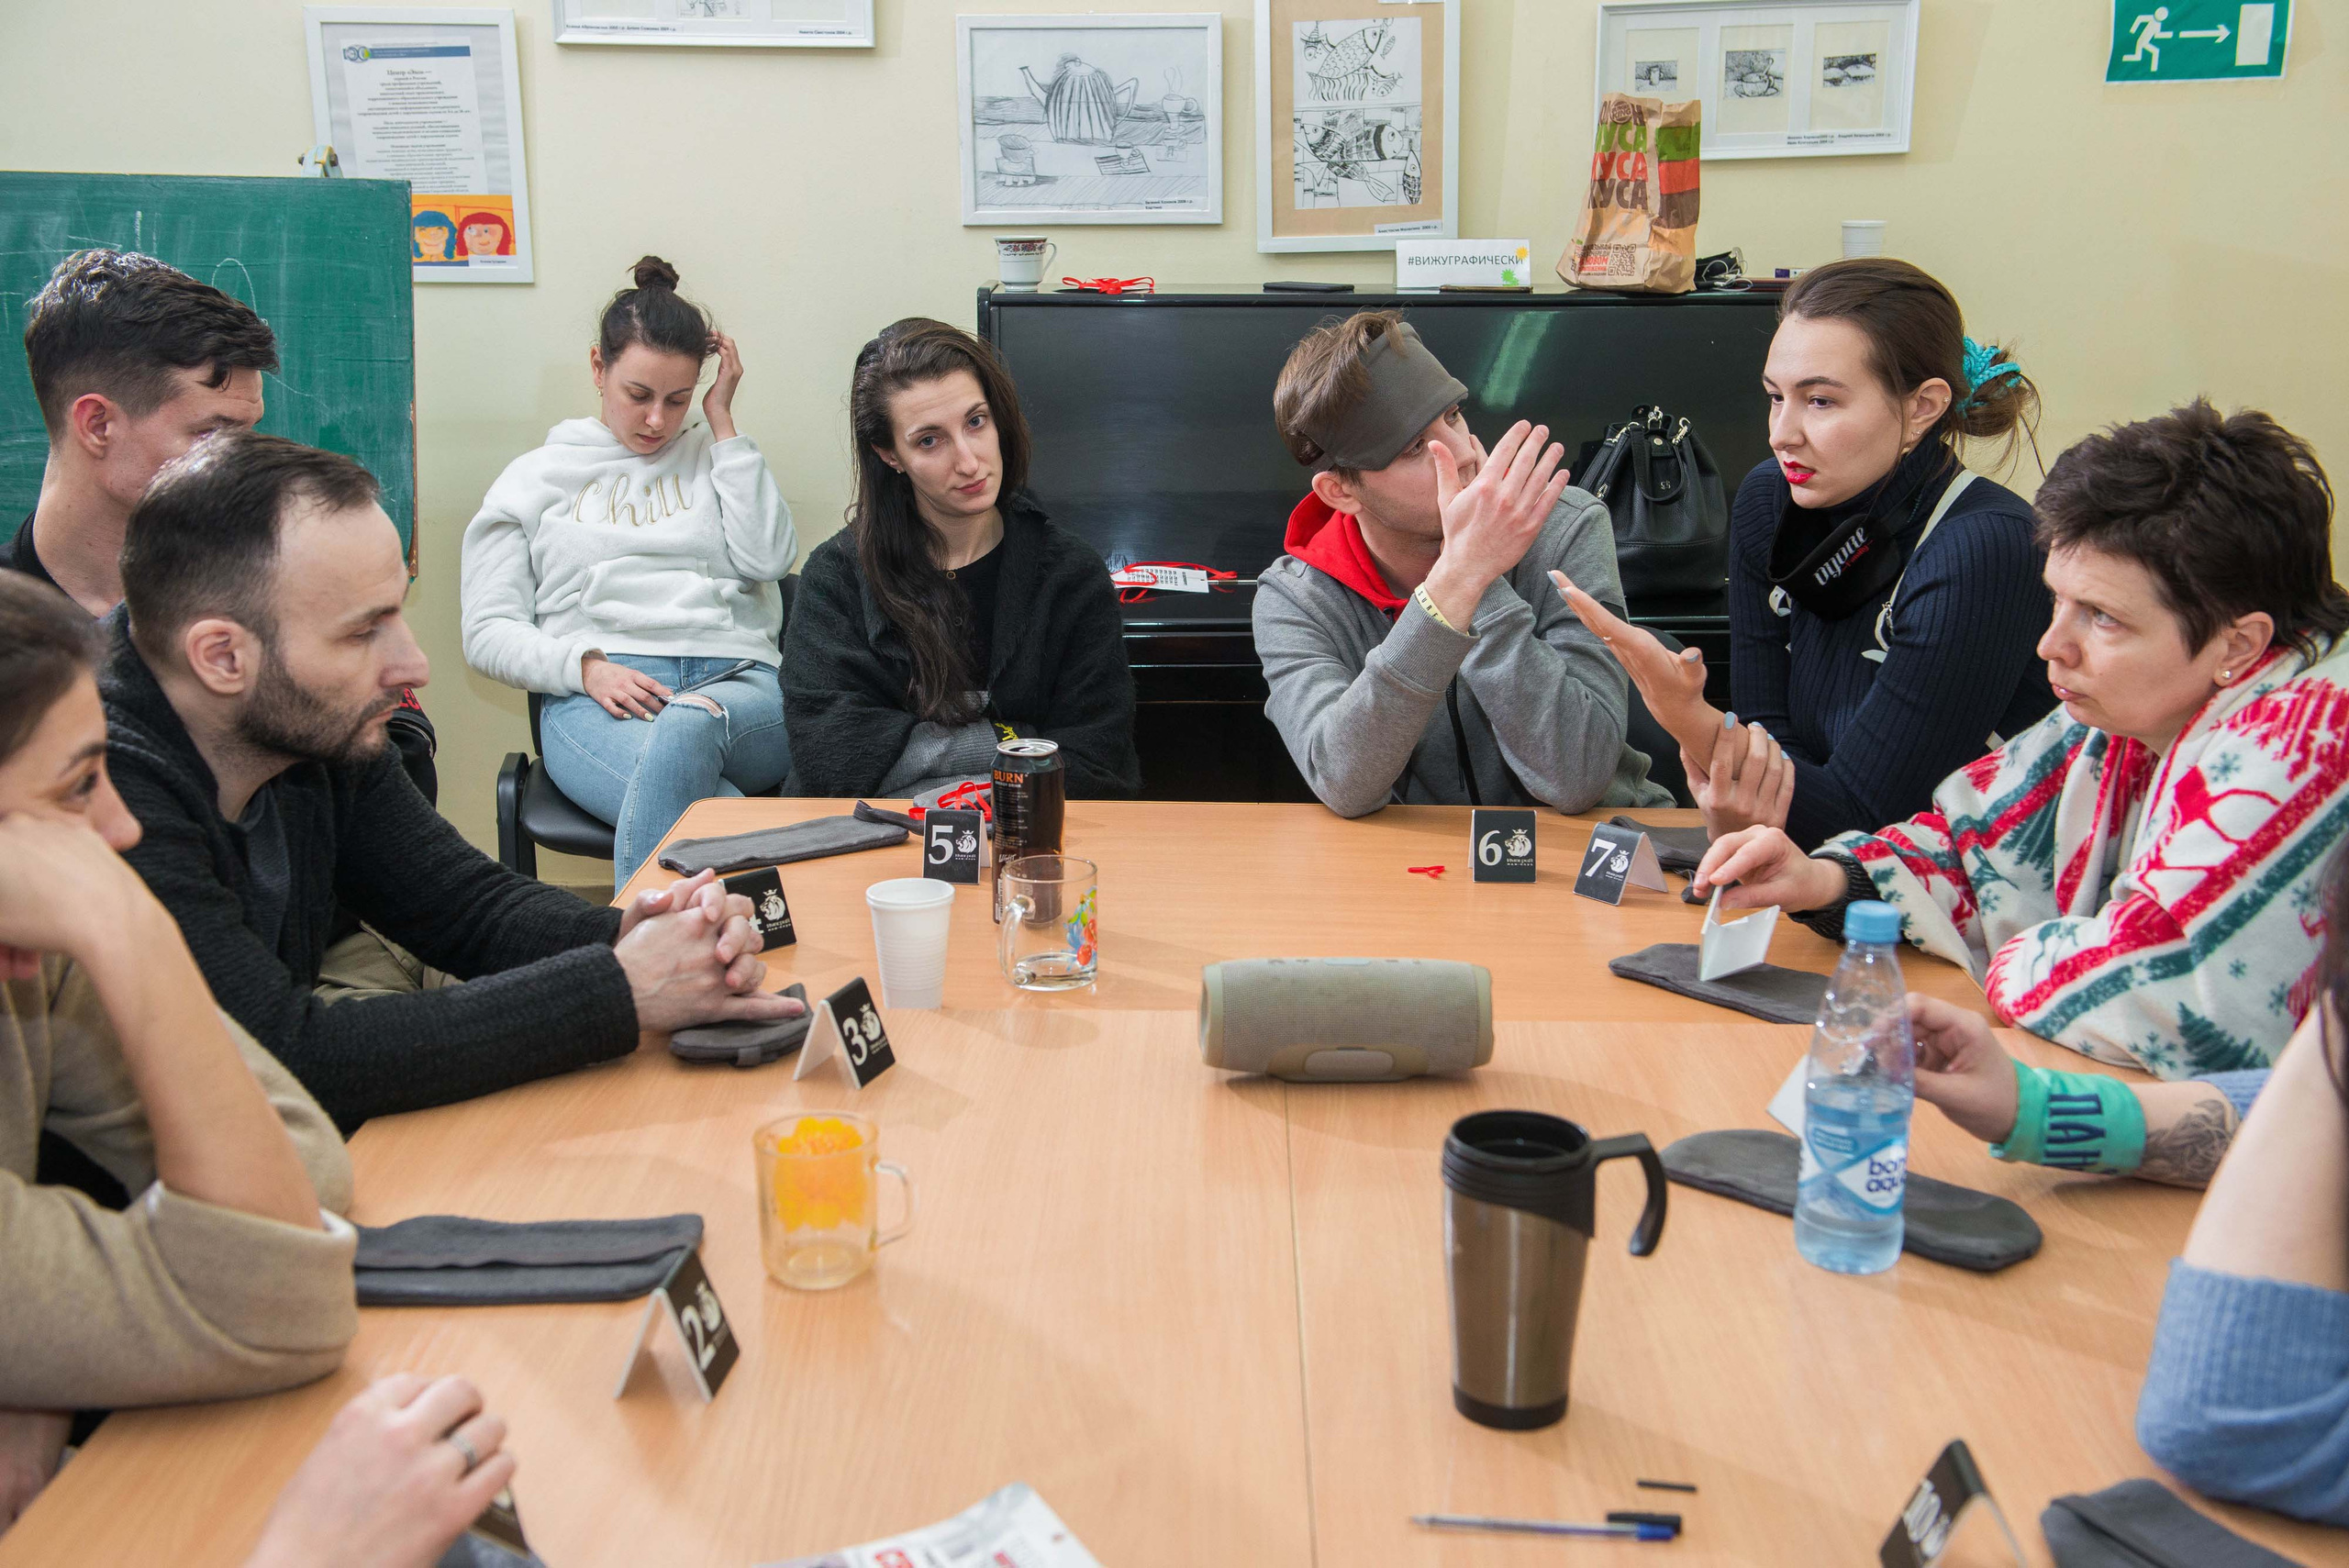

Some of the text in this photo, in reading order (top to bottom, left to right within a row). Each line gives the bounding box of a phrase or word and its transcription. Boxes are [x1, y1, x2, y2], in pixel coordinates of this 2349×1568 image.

[1612, 109, 1631, 119] KING
[1408, 254, 1524, 267] #ВИЖУГРАФИЧЕСКИ
[572, 473, 694, 527] Chill
[993, 769, 1024, 784] BURN
[928, 825, 954, 865] 5
[1478, 829, 1503, 866] 6
[1585, 837, 1618, 877] 7
[842, 1017, 868, 1066] 3
[2041, 1092, 2109, 1173] ПАН
[681, 1304, 718, 1372] 2
